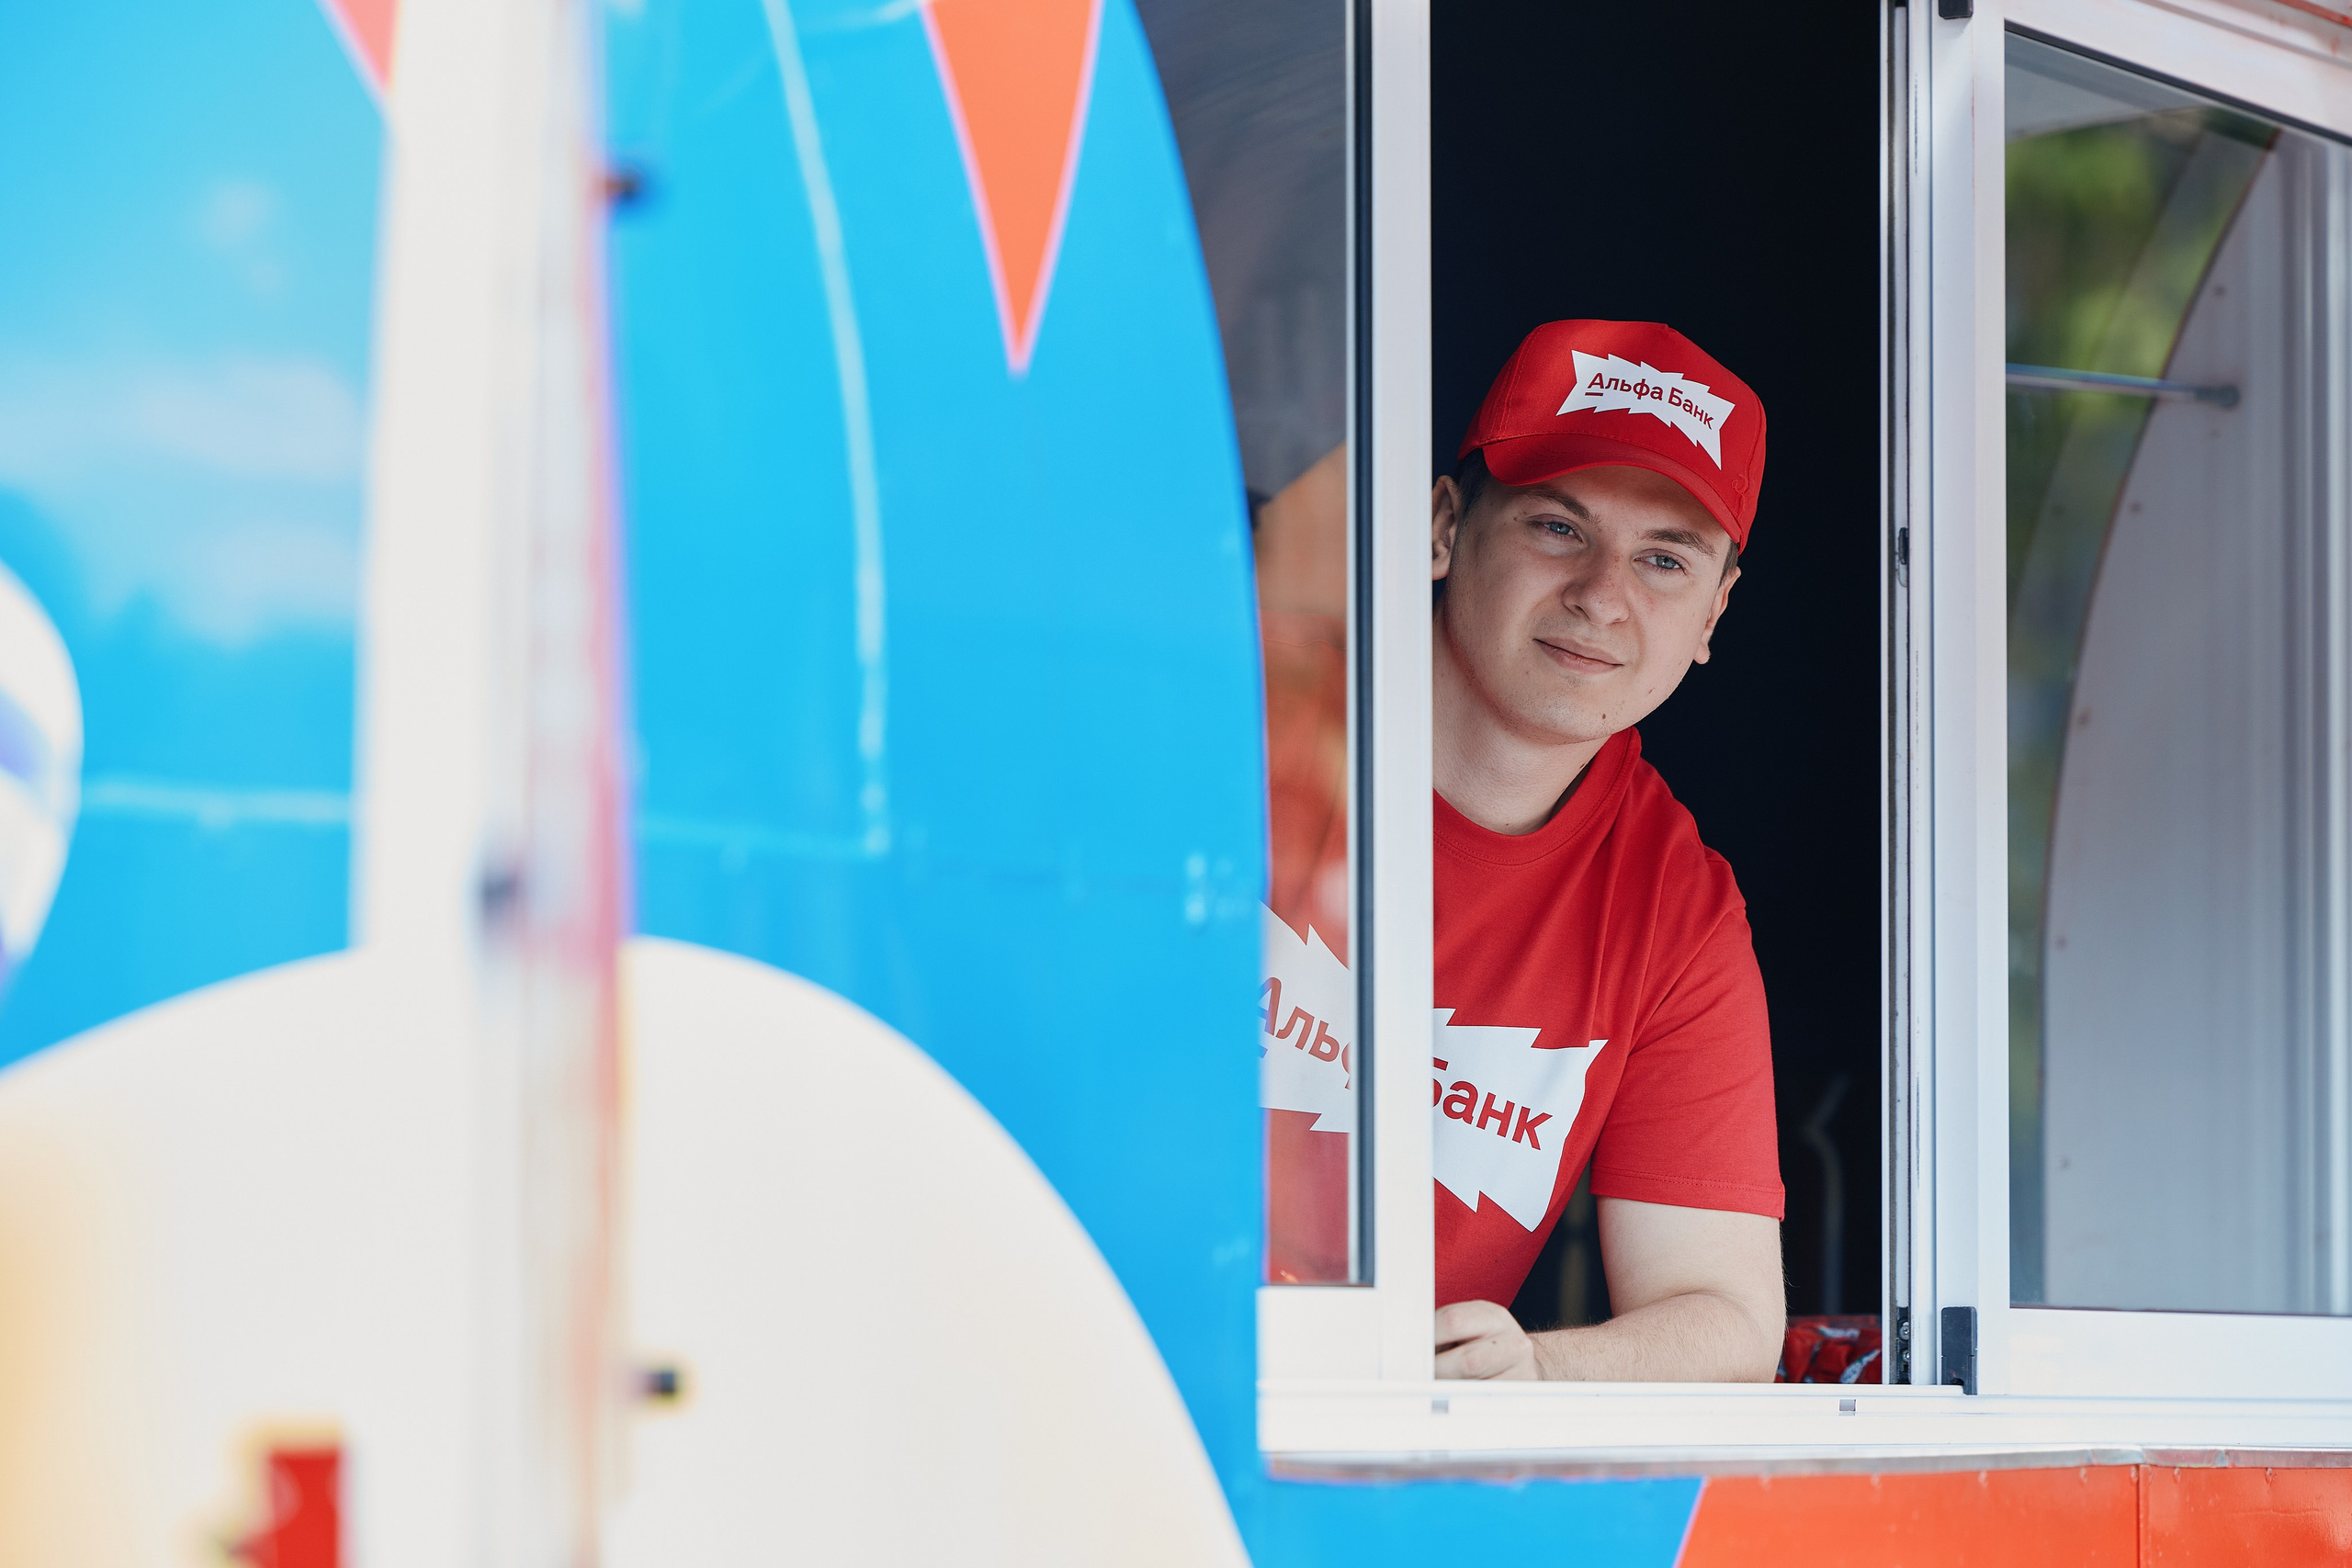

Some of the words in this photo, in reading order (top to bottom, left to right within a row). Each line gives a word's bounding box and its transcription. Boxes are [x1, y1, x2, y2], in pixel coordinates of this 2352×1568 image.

[1585, 372, 1664, 400] Альфа
[1668, 387, 1714, 430] Банк
[1257, 976, 1351, 1090] Аль
